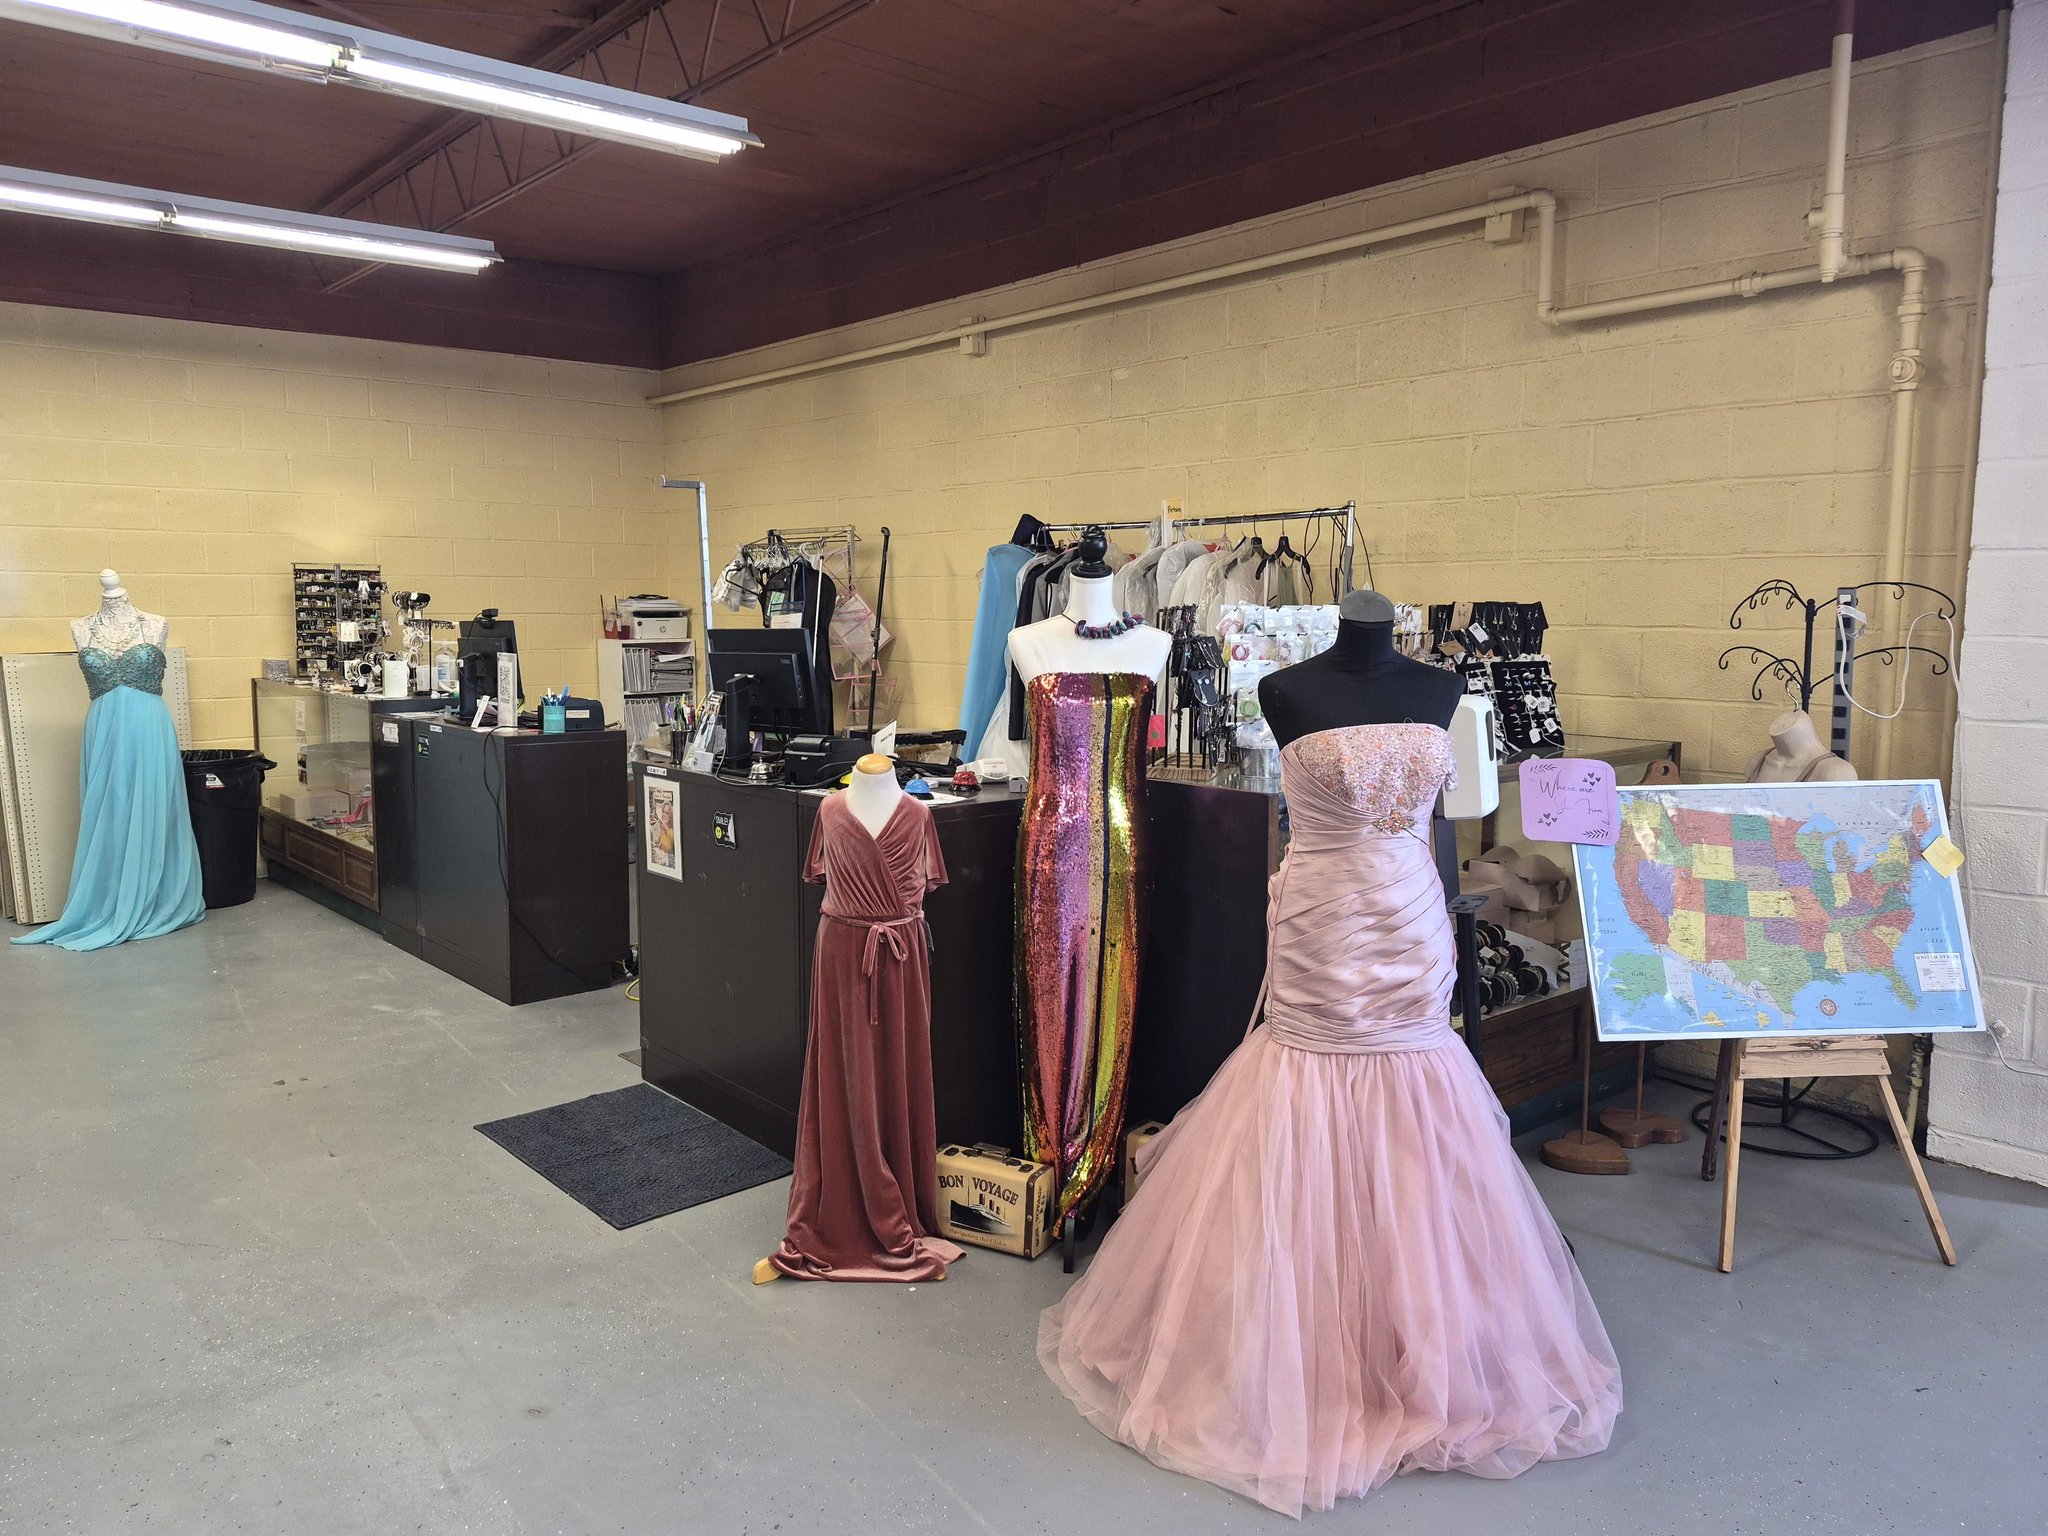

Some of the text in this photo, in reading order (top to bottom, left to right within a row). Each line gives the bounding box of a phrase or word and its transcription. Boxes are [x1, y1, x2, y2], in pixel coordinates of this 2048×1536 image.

[1540, 770, 1577, 798] Where
[937, 1174, 1019, 1206] BON VOYAGE
